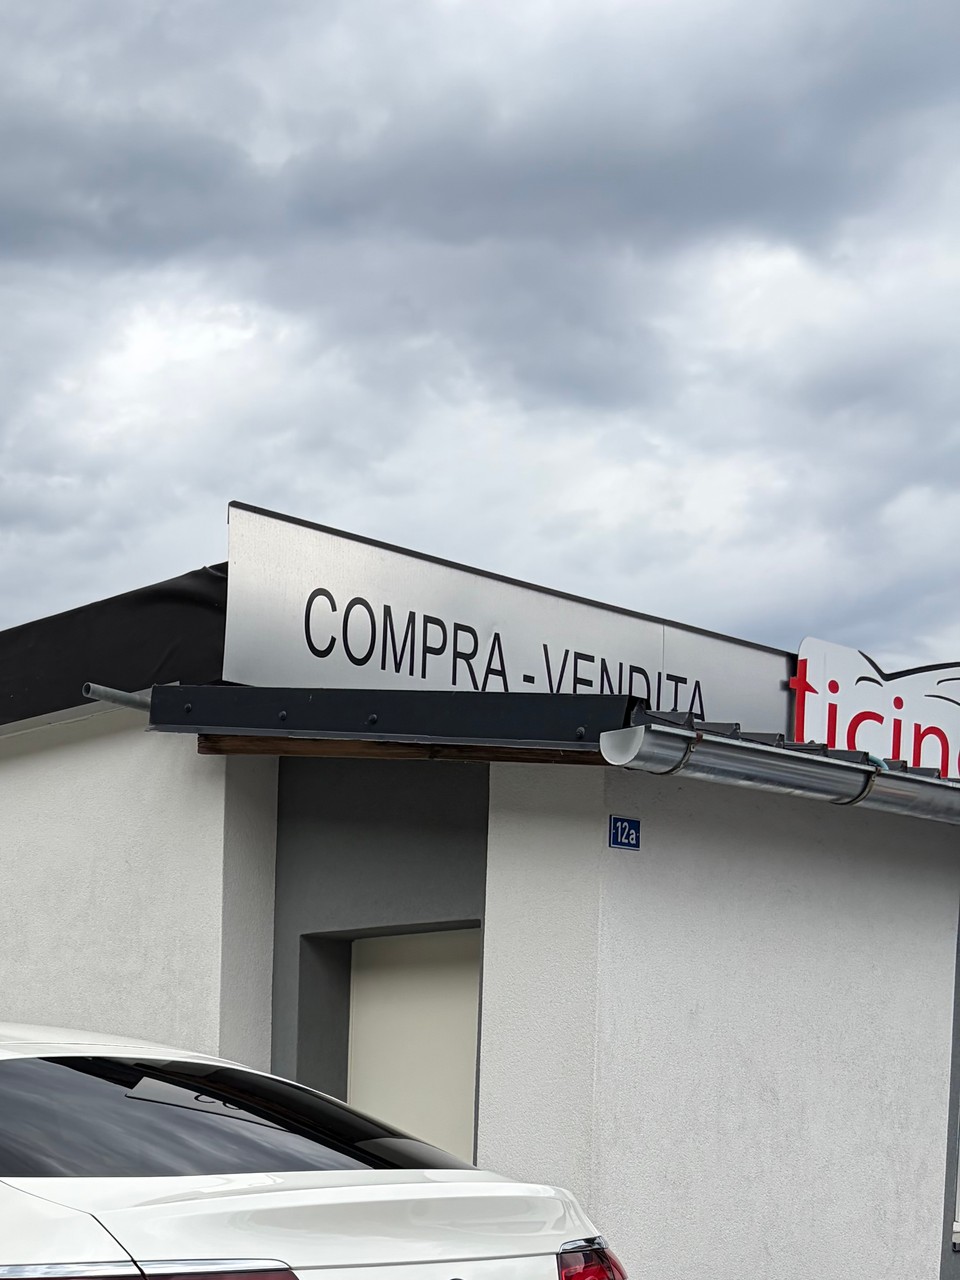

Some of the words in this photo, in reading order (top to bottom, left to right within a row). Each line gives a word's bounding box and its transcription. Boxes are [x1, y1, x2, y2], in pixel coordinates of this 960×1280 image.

[304, 587, 509, 692] COMPRA
[542, 643, 706, 722] VENDITA
[789, 658, 960, 779] ticin
[616, 821, 636, 844] 12a
